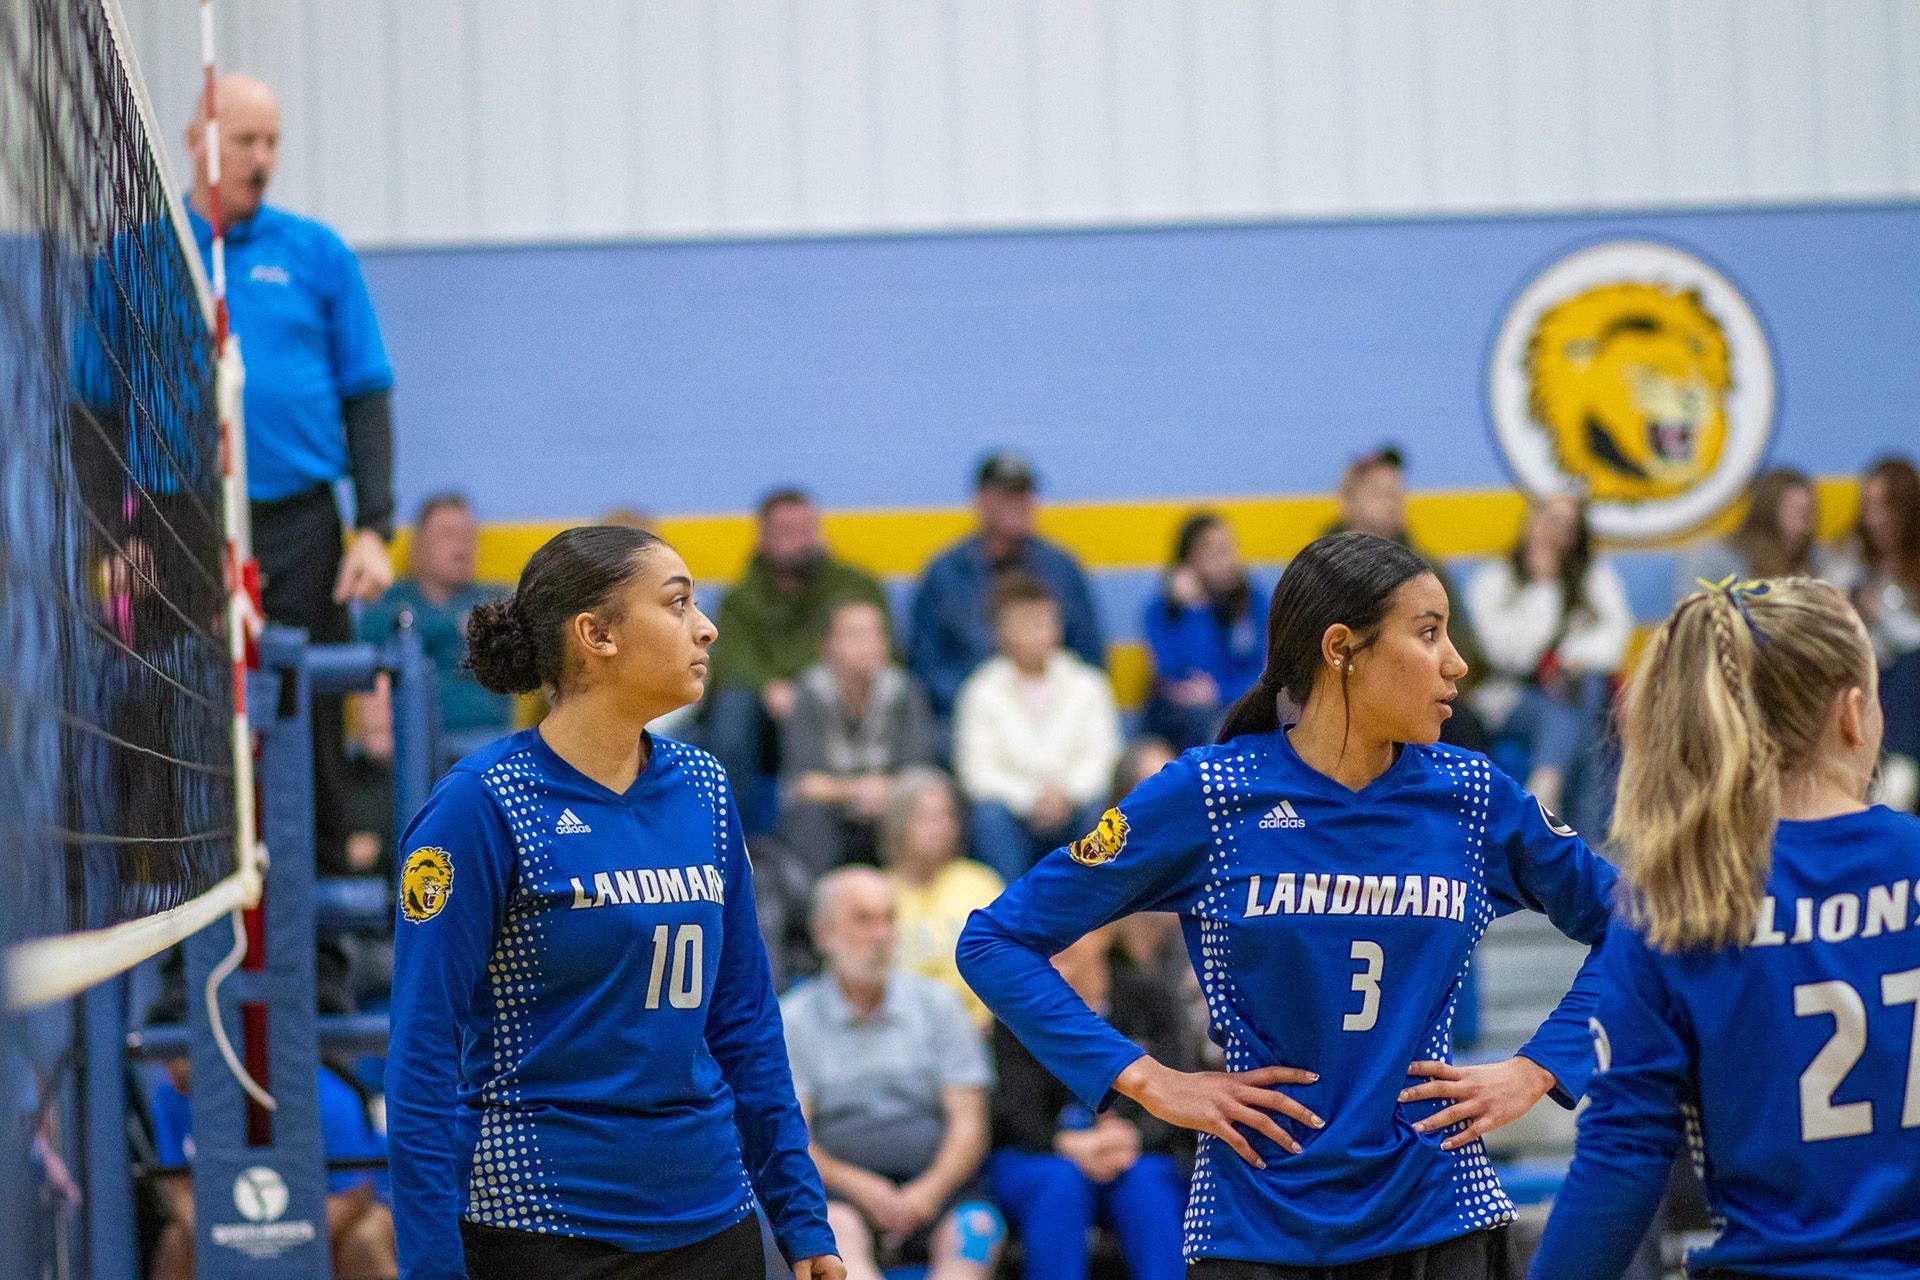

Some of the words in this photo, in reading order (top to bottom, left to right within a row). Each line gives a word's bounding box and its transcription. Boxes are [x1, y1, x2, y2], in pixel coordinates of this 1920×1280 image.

[555, 822, 592, 834] adidas
[1258, 816, 1306, 829] adidas
[1243, 873, 1467, 922] LANDMARK
[645, 924, 703, 1009] 10
[1342, 940, 1384, 1031] 3
[1794, 967, 1920, 1141] 27
